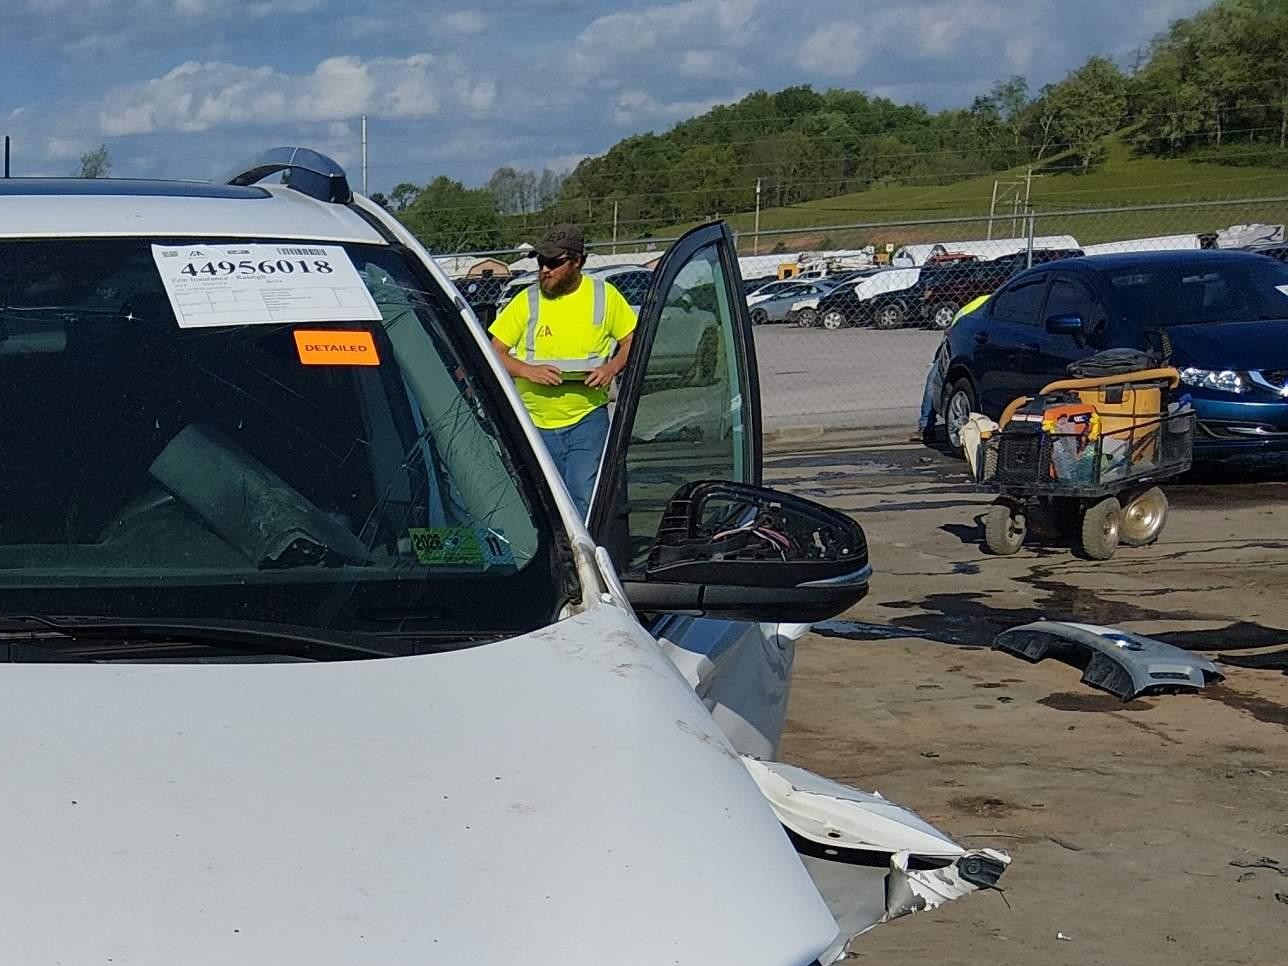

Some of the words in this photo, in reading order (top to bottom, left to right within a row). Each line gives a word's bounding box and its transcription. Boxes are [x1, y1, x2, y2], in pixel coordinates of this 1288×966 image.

[181, 259, 333, 277] 44956018
[305, 344, 368, 353] DETAILED
[484, 534, 503, 556] 11
